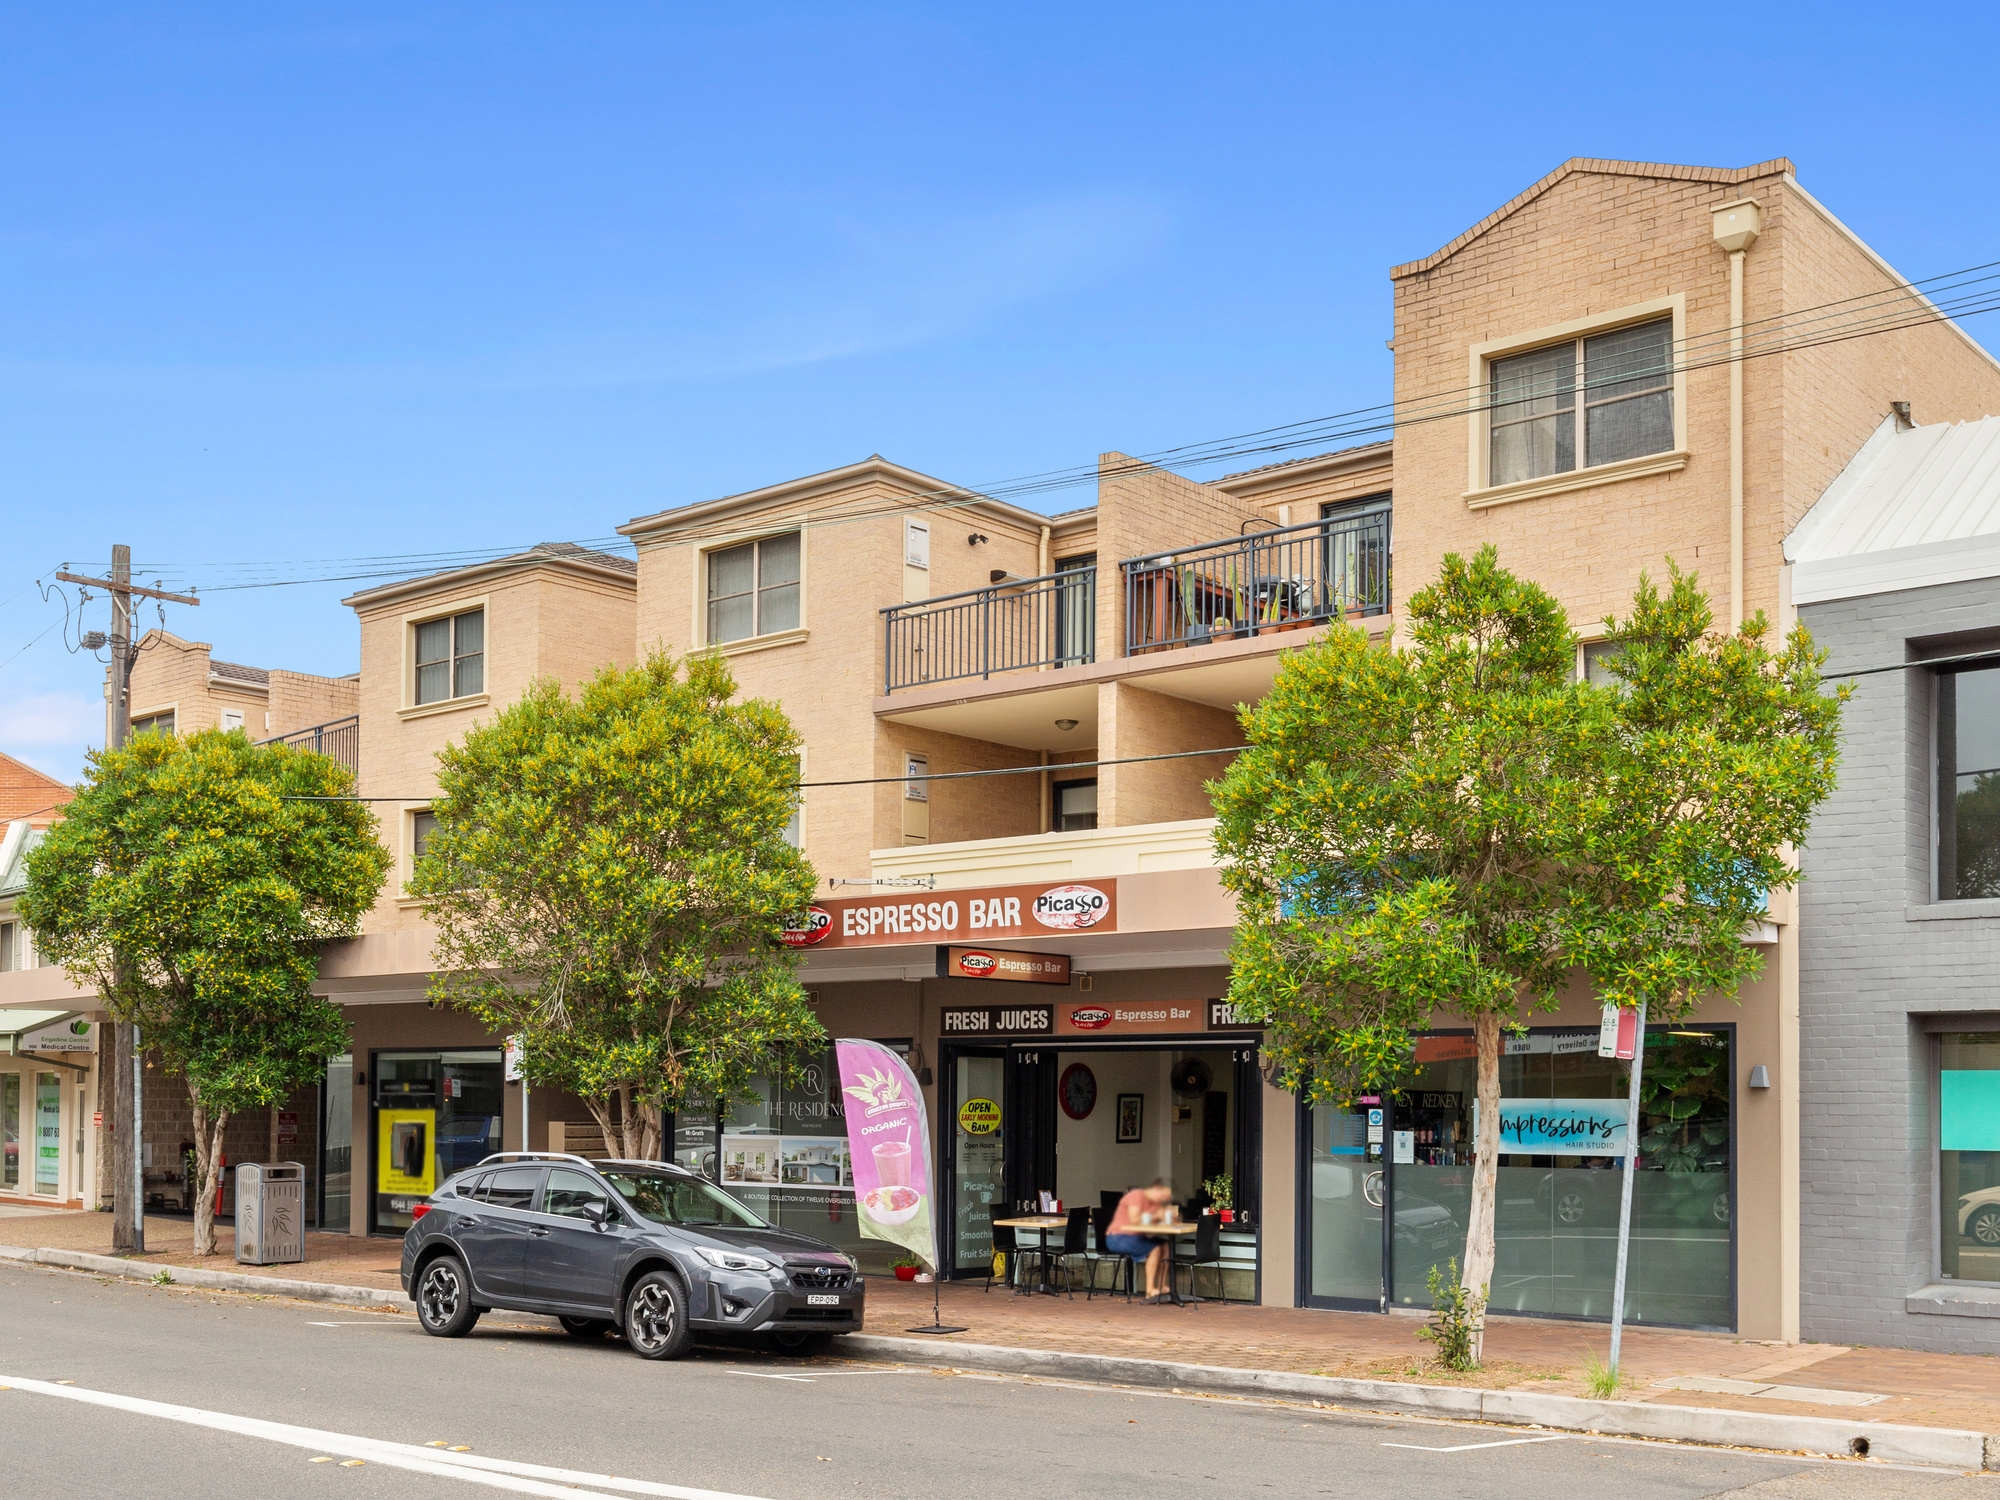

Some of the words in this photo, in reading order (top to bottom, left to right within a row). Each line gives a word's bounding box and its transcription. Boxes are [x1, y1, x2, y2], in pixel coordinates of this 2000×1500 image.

[1036, 893, 1103, 914] Picasso
[842, 900, 959, 937] ESPRESSO
[969, 896, 1022, 929] BAR
[961, 955, 994, 968] Picasso
[999, 957, 1042, 972] Espresso
[1044, 961, 1061, 973] Bar
[945, 1011, 989, 1030] FRESH
[996, 1010, 1049, 1030] JUICES
[1072, 1010, 1109, 1021] Picasso
[1114, 1008, 1167, 1022] Espresso
[1170, 1007, 1191, 1019] Bar
[1422, 1092, 1458, 1108] REDKEN
[763, 1102, 785, 1116] THE
[790, 1102, 845, 1120] RESIDENC
[867, 1103, 889, 1116] amazon
[888, 1101, 907, 1109] power
[968, 1102, 992, 1113] OPEN
[961, 1113, 977, 1122] EARLY
[977, 1113, 999, 1121] MORNING
[861, 1117, 907, 1135] ORGANIC
[971, 1122, 990, 1133] 6AM
[1499, 1110, 1628, 1144] mpressions
[964, 1142, 979, 1150] Open
[1565, 1141, 1584, 1149] HAIR
[1585, 1141, 1615, 1150] STUDIO
[963, 1181, 995, 1191] Picasso
[770, 1194, 798, 1202] COLLECTION
[825, 1196, 850, 1204] OVERSIZED
[957, 1200, 974, 1218] Fresh
[968, 1211, 990, 1223] Juices
[960, 1230, 993, 1240] Smoothie
[960, 1249, 978, 1259] Fruit
[978, 1248, 992, 1258] Sala
